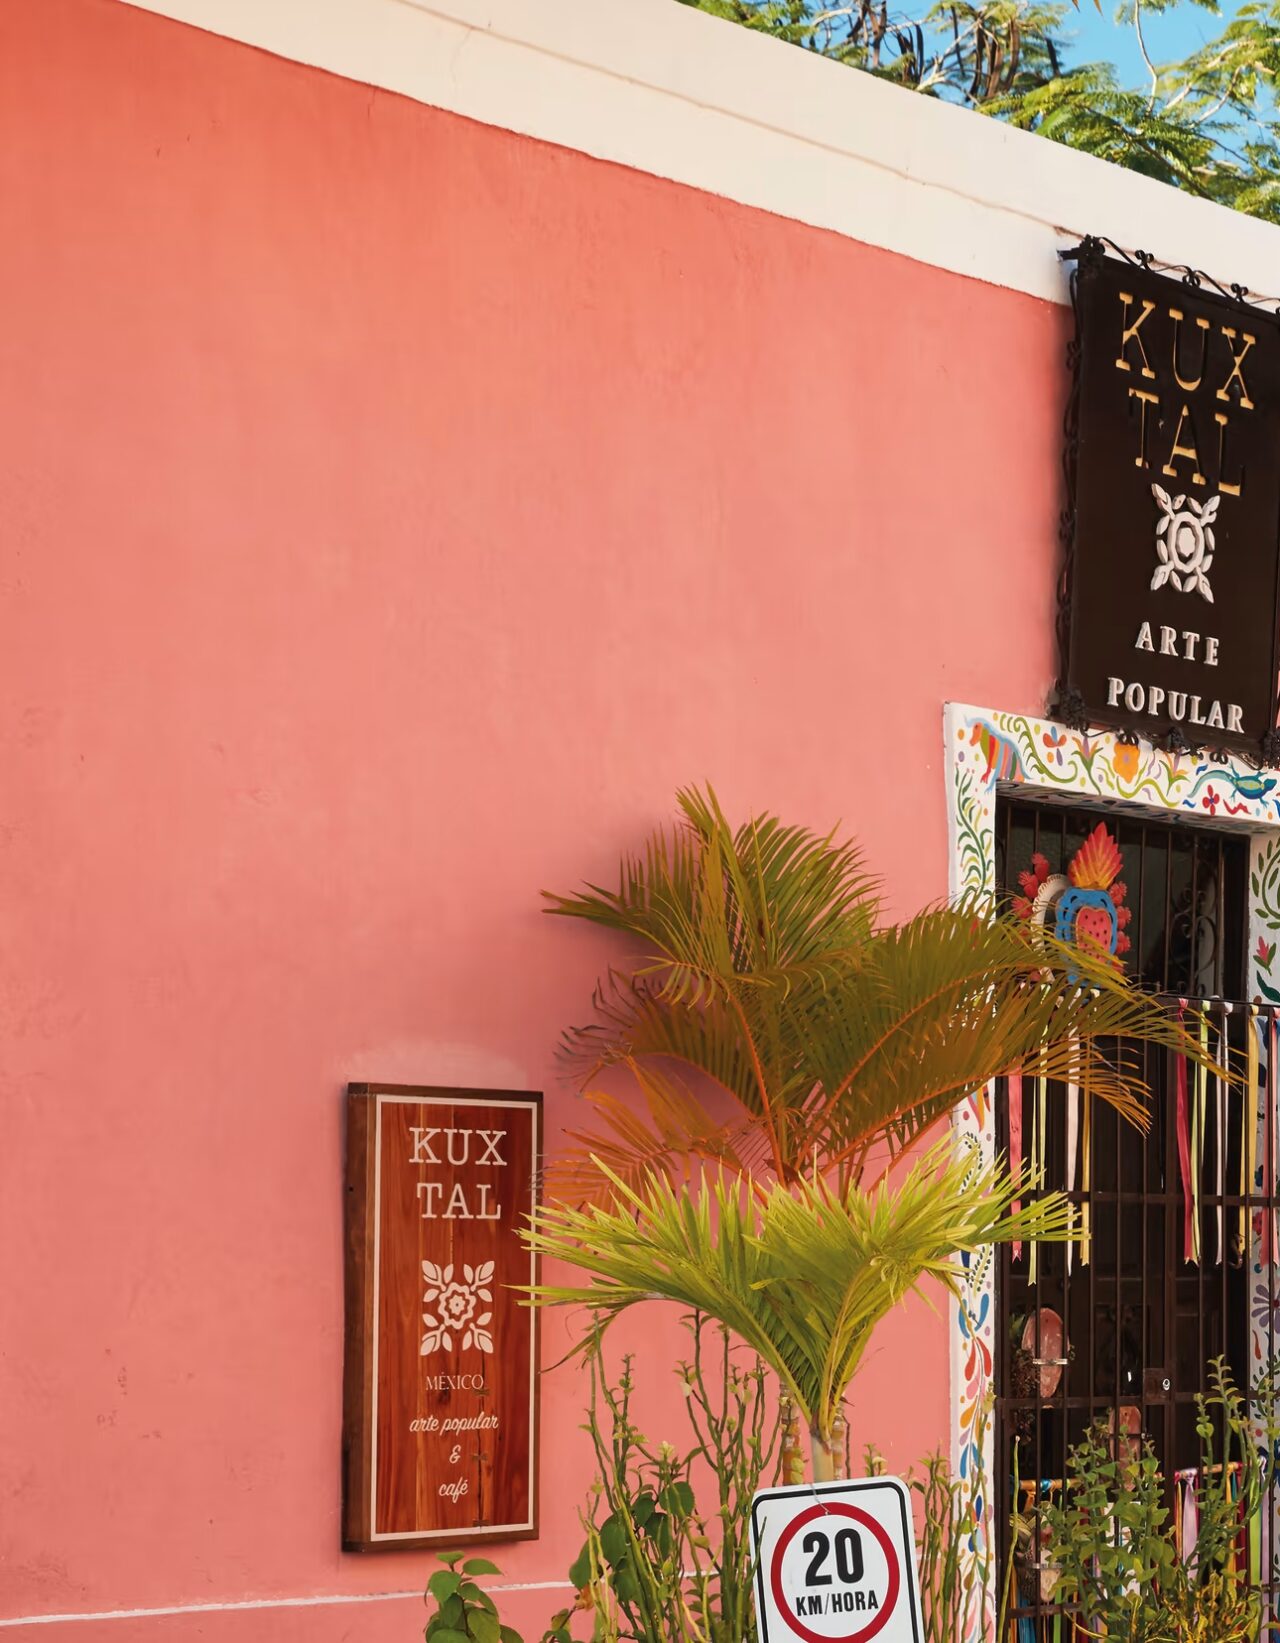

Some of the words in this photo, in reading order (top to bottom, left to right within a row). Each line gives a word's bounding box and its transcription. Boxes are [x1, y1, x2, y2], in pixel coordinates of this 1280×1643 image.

[1115, 291, 1256, 410] KUX
[1128, 387, 1242, 497] TAL
[1134, 621, 1220, 667] ARTE
[1106, 677, 1245, 734] POPULAR
[408, 1126, 508, 1167] KUX
[416, 1182, 502, 1220] TAL
[409, 1415, 439, 1432] arte
[439, 1411, 499, 1436] popular
[449, 1444, 462, 1464] &
[438, 1477, 469, 1503] café
[802, 1528, 865, 1587] 20
[795, 1590, 879, 1617] KM/HORA
